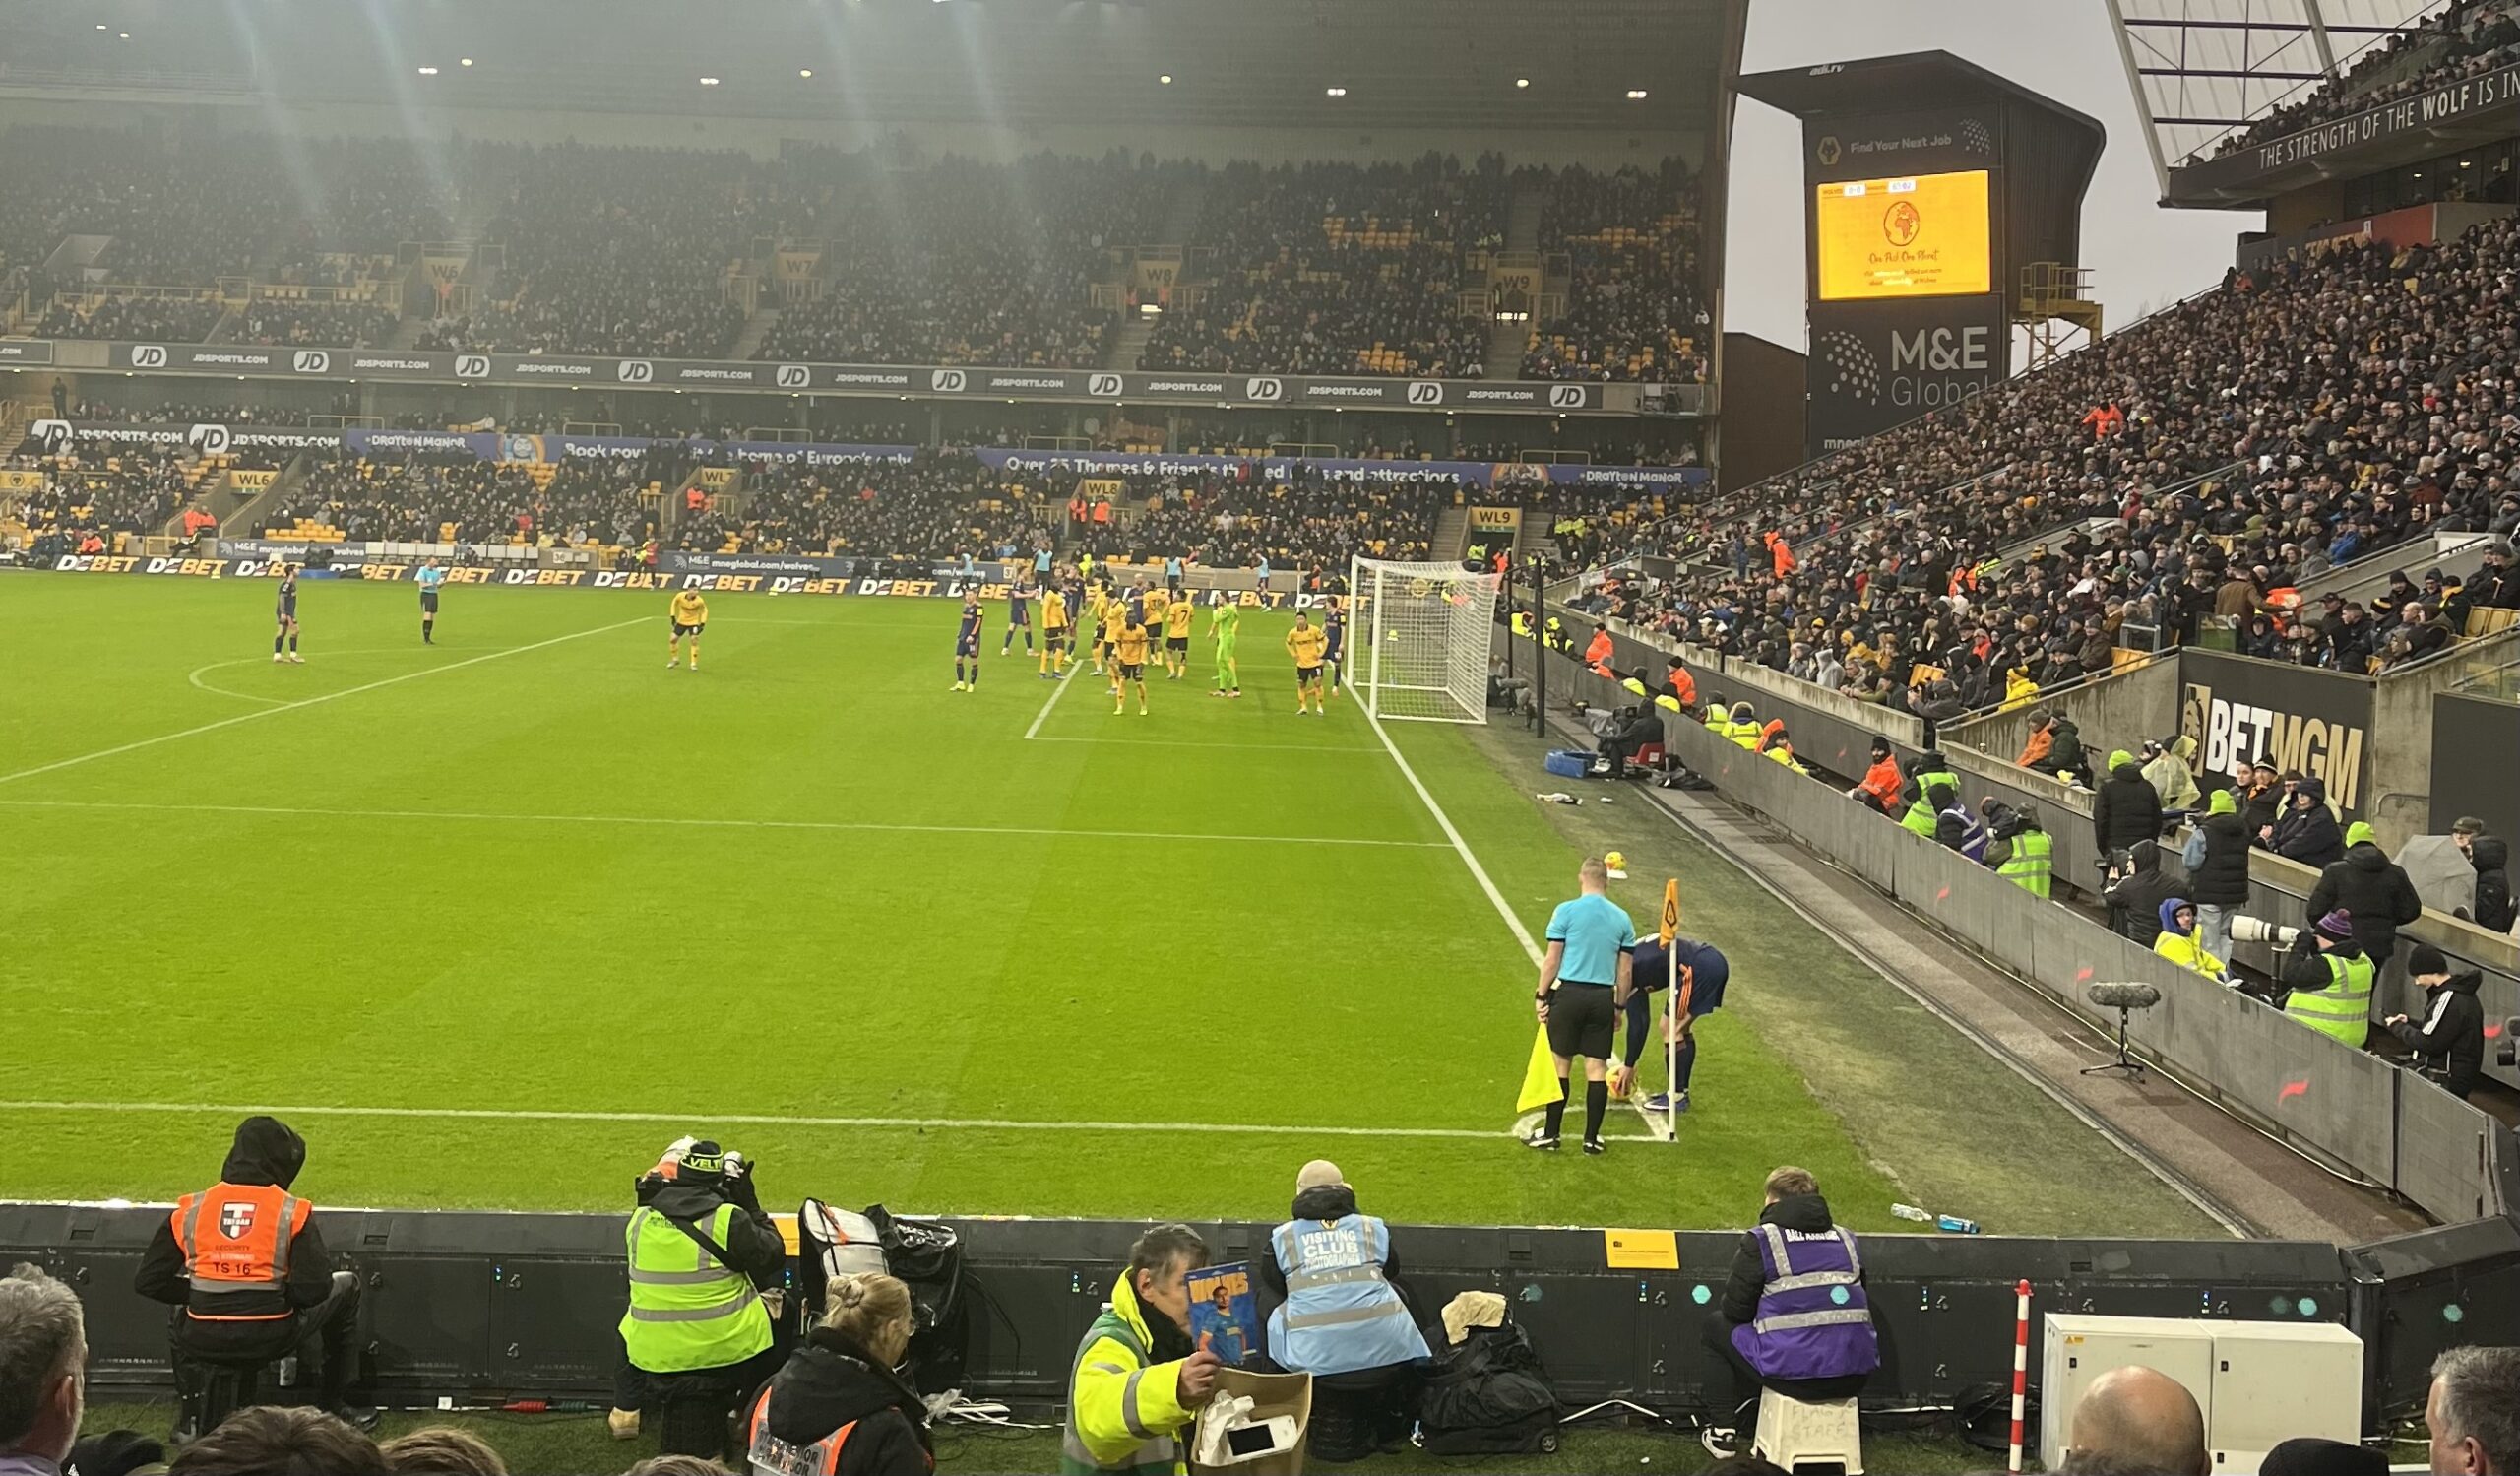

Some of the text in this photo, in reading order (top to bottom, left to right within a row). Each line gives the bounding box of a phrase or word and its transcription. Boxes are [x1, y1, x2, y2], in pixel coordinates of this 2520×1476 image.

[2260, 148, 2282, 170] THE
[2287, 120, 2357, 161] STRENGTH
[2362, 113, 2380, 140] OF
[2387, 102, 2415, 132] THE
[2422, 84, 2469, 121] WOLF
[2478, 77, 2494, 106] IS
[1850, 134, 1953, 154] Find Your Next Job
[788, 260, 813, 274] W7
[1146, 268, 1172, 283] W8
[1503, 276, 1530, 289] W9
[1892, 326, 1988, 371] M&E
[135, 347, 1582, 406] JD JDSPORTS.COM JD JDSPORTS.COM JD JDSPORTS.COM JD JDSPORTS.COM JD JDSPORTS.COM JD JDSPORTS.COM JD JDSPORTS.COM JD JDSPORTS.COM JD JDSPORTS.COM JD
[1143, 461, 1156, 476] &
[238, 473, 270, 485] WL6
[1088, 482, 1117, 494] WL8
[1479, 511, 1511, 523] WL9
[147, 558, 229, 575] DEBET
[505, 568, 586, 585] DEBET
[858, 579, 938, 597] DEBET
[1180, 610, 1188, 621] 7
[1300, 1229, 1356, 1246] VISITING
[1303, 1242, 1359, 1258] CLUB
[213, 1261, 251, 1276] TS 16
